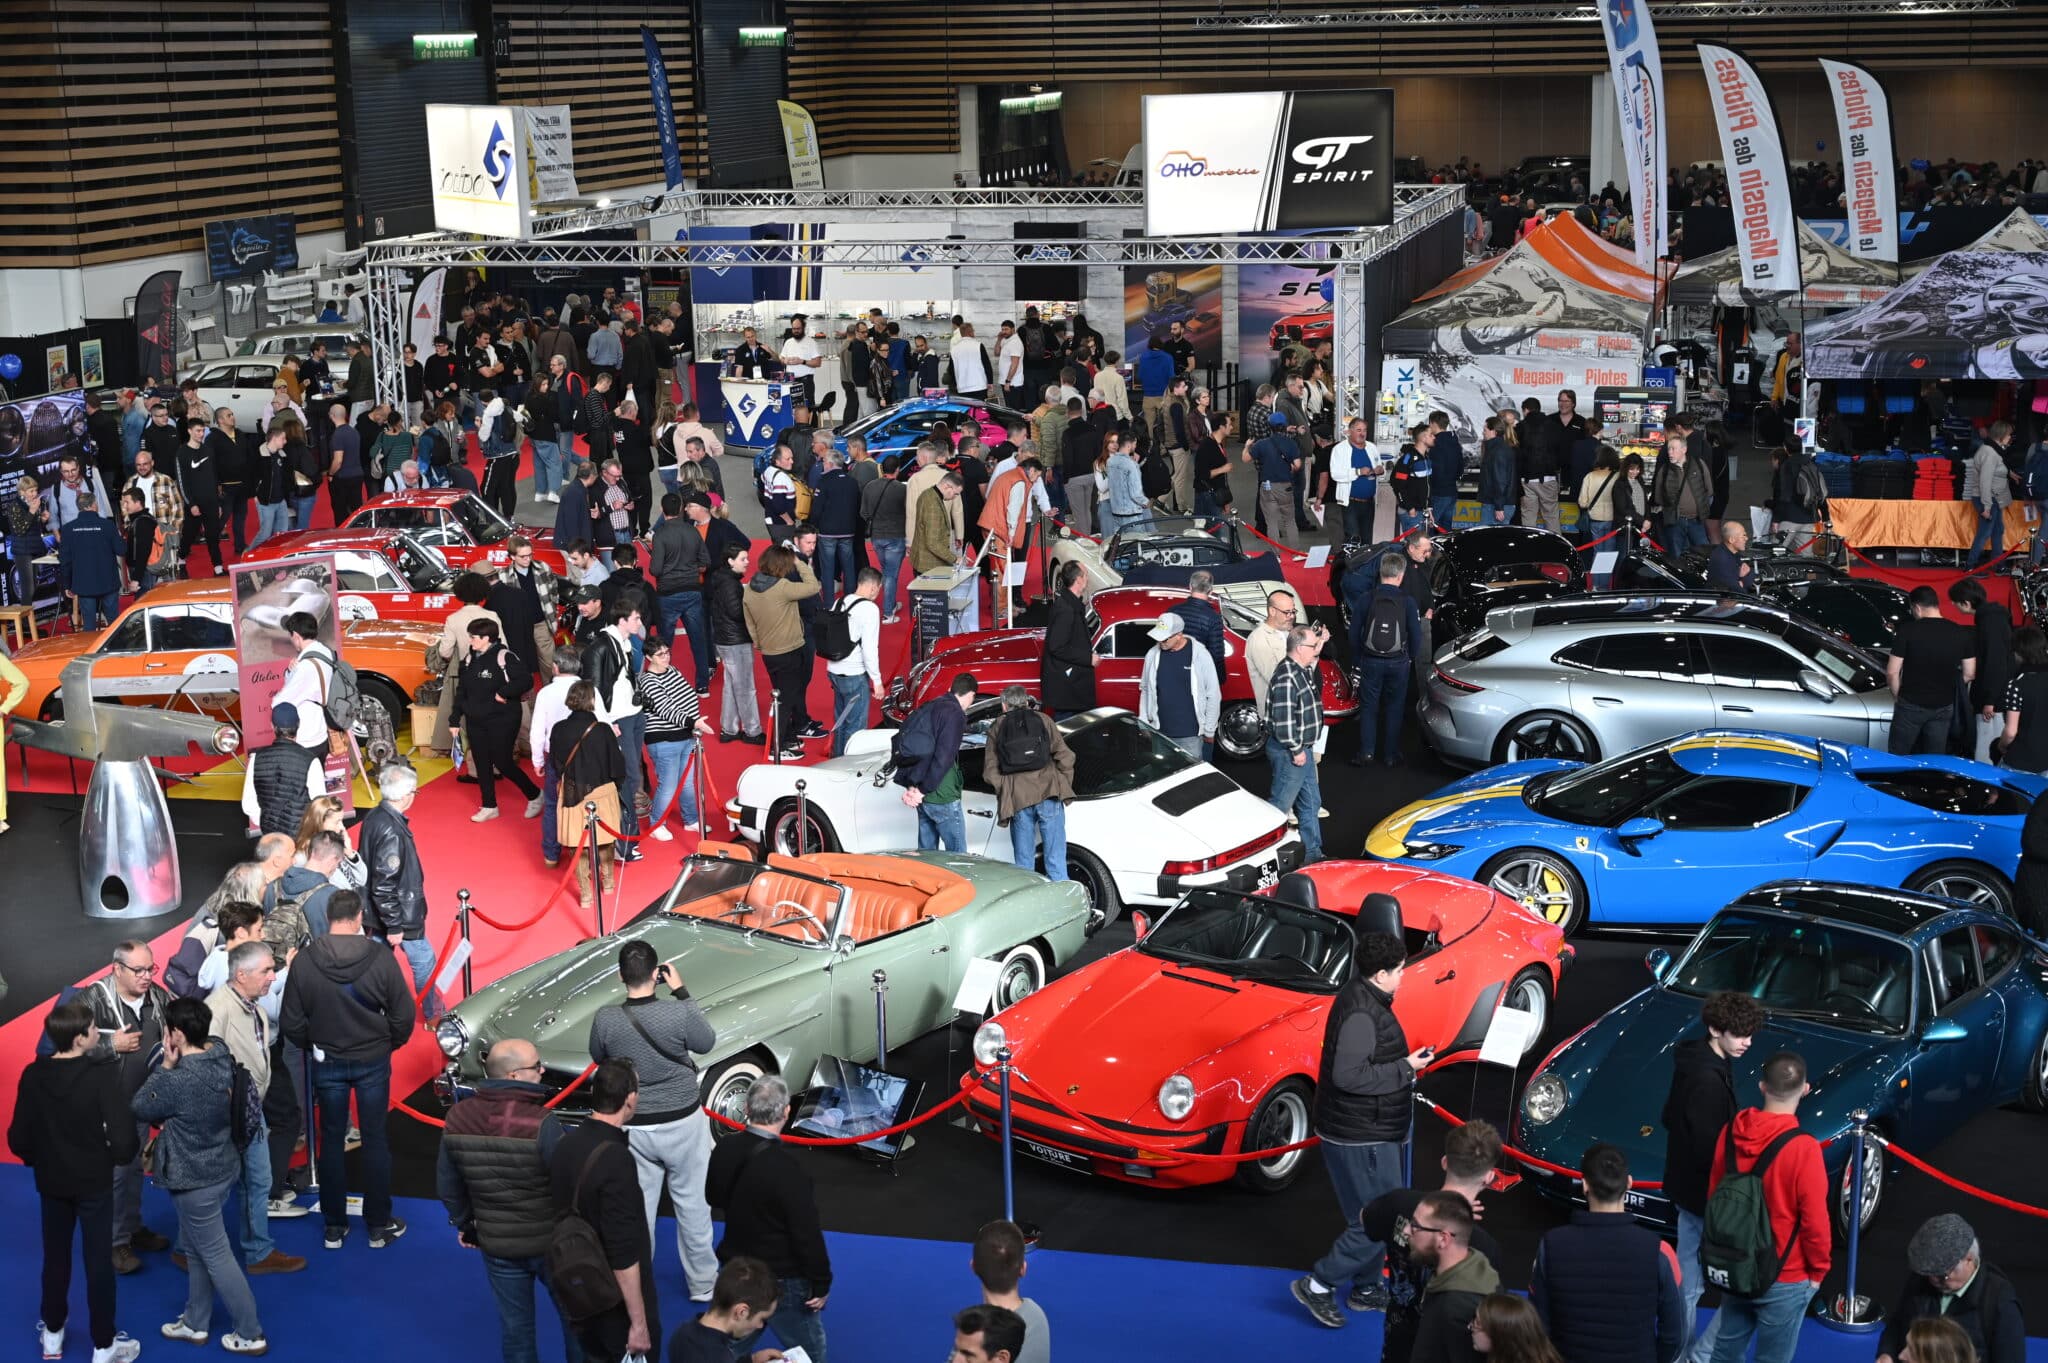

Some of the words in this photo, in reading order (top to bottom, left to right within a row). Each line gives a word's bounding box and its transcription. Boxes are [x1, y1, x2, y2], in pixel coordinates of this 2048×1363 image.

[1292, 135, 1374, 170] GT
[1292, 170, 1374, 183] SPIRIT
[1537, 333, 1582, 350] Magasin
[1597, 335, 1633, 351] Pilotes
[1513, 367, 1565, 387] Magasin
[1585, 368, 1629, 386] Pilotes
[423, 594, 450, 609] HF
[251, 670, 281, 685] Atelier
[1028, 1143, 1072, 1163] VOITURE
